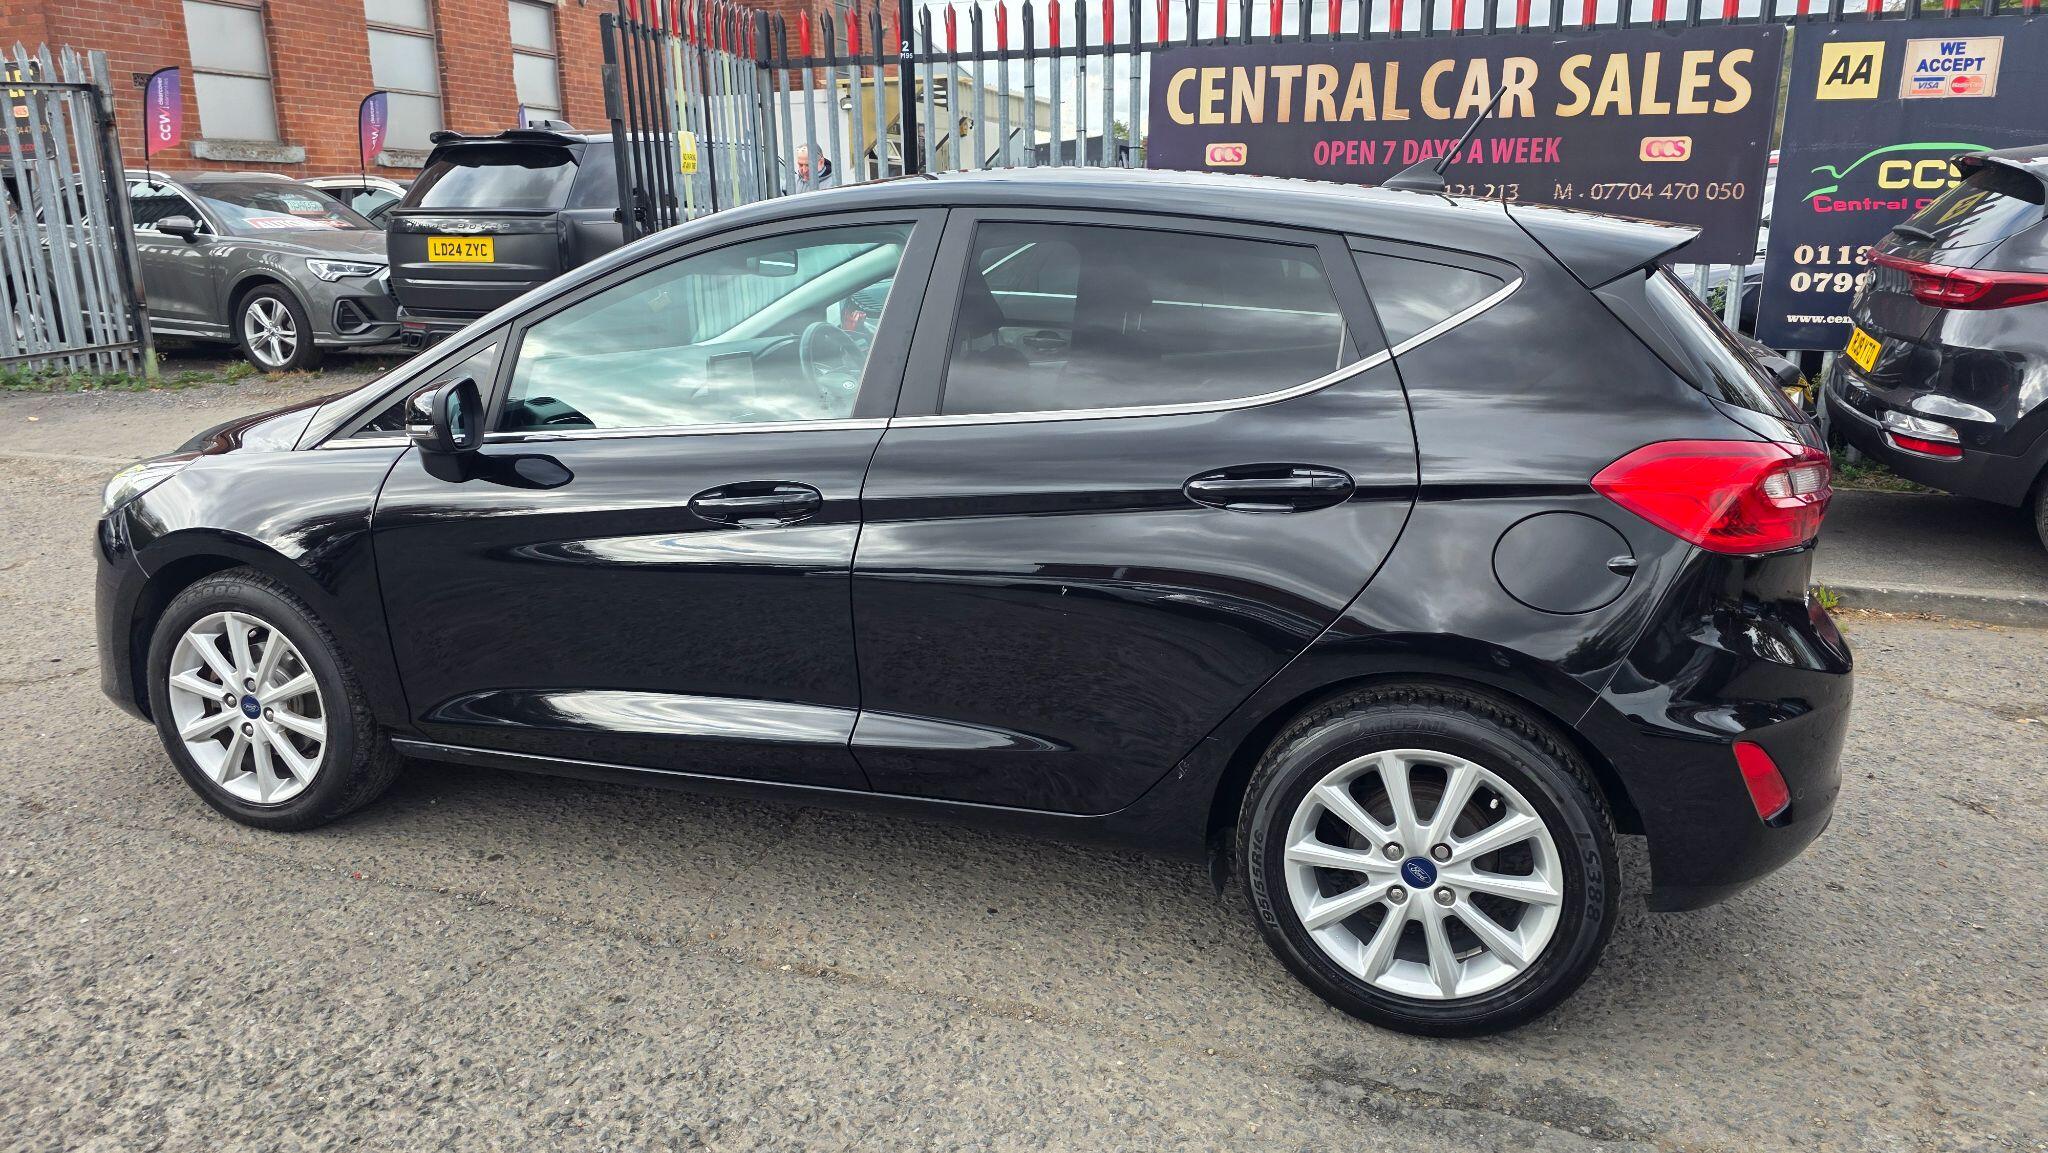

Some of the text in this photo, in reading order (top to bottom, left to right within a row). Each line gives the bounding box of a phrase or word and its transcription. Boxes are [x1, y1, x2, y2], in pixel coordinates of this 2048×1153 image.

[902, 40, 910, 52] 2
[1940, 42, 1967, 56] WE
[1825, 55, 1874, 86] AA
[1916, 57, 1986, 73] ACCEPT
[1166, 48, 1754, 126] CENTRAL CAR SALES
[1917, 82, 1940, 90] VISA
[159, 106, 171, 141] CCW
[1209, 146, 1243, 164] CCS
[1314, 136, 1564, 165] OPEN 7 DAYS A WEEK
[1645, 139, 1686, 158] CCS
[1484, 183, 1520, 200] 213
[1553, 183, 1573, 200] M
[1590, 182, 1654, 200] 07704
[1659, 182, 1699, 200] 470
[1705, 182, 1746, 200] 050
[1813, 196, 1908, 213] Central
[433, 243, 488, 257] LD24 ZYC
[1787, 314, 1854, 324] www.cen
